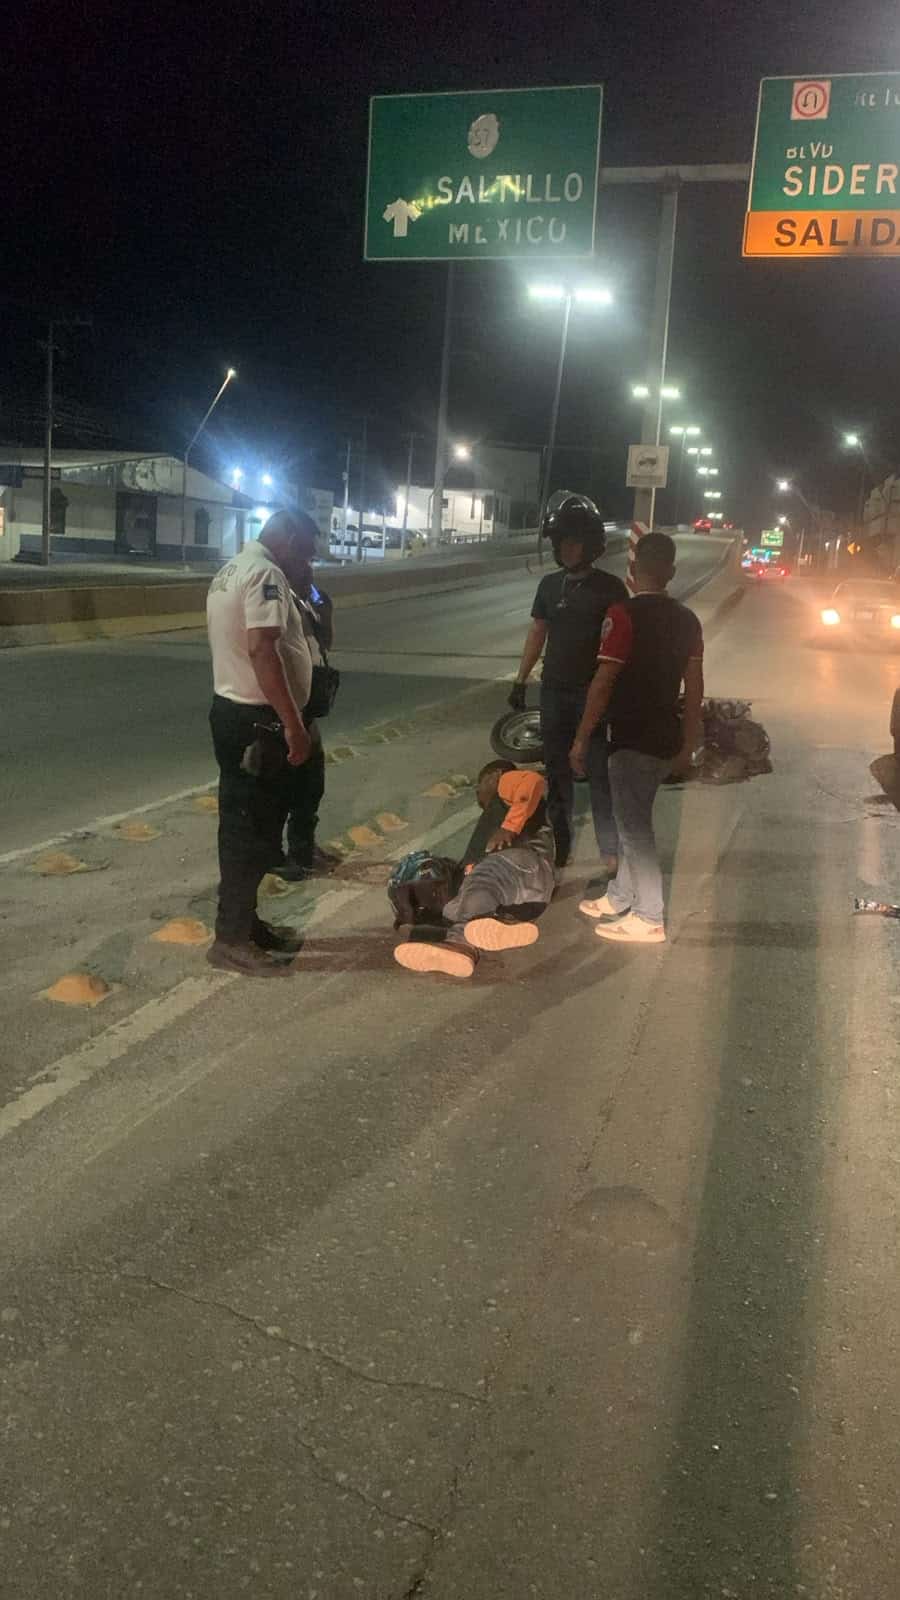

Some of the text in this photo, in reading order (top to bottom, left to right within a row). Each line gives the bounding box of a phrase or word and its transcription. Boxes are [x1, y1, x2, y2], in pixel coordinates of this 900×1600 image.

[437, 171, 584, 205] SALTILLO
[783, 163, 899, 197] SIDER
[774, 218, 900, 247] SALID
